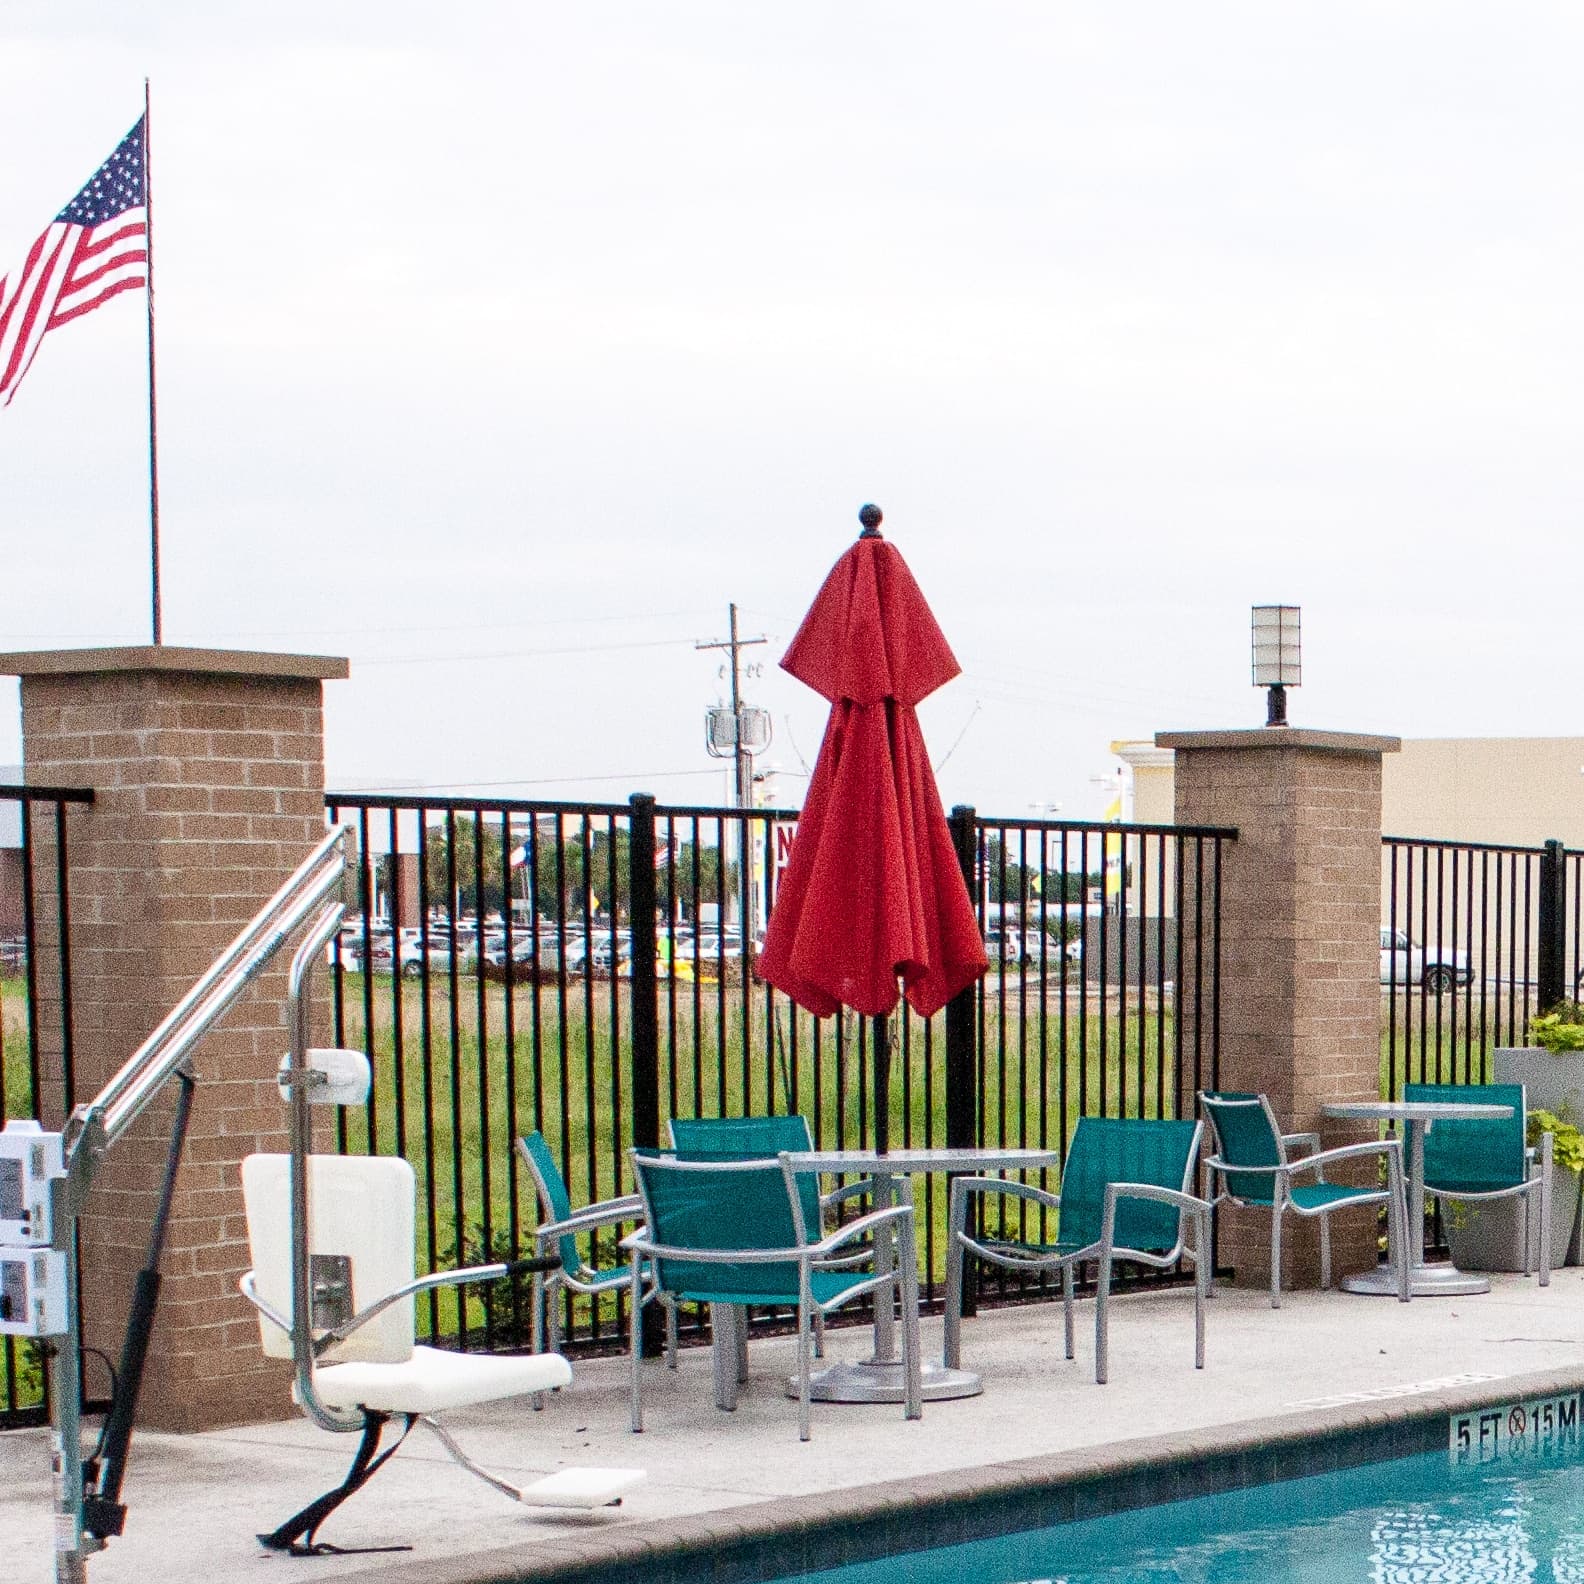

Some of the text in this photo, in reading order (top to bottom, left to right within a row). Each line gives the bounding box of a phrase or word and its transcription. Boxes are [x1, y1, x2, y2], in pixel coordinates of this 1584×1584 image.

[1458, 1419, 1470, 1447] 5
[1479, 1413, 1502, 1443] FT
[1558, 1399, 1577, 1428] M
